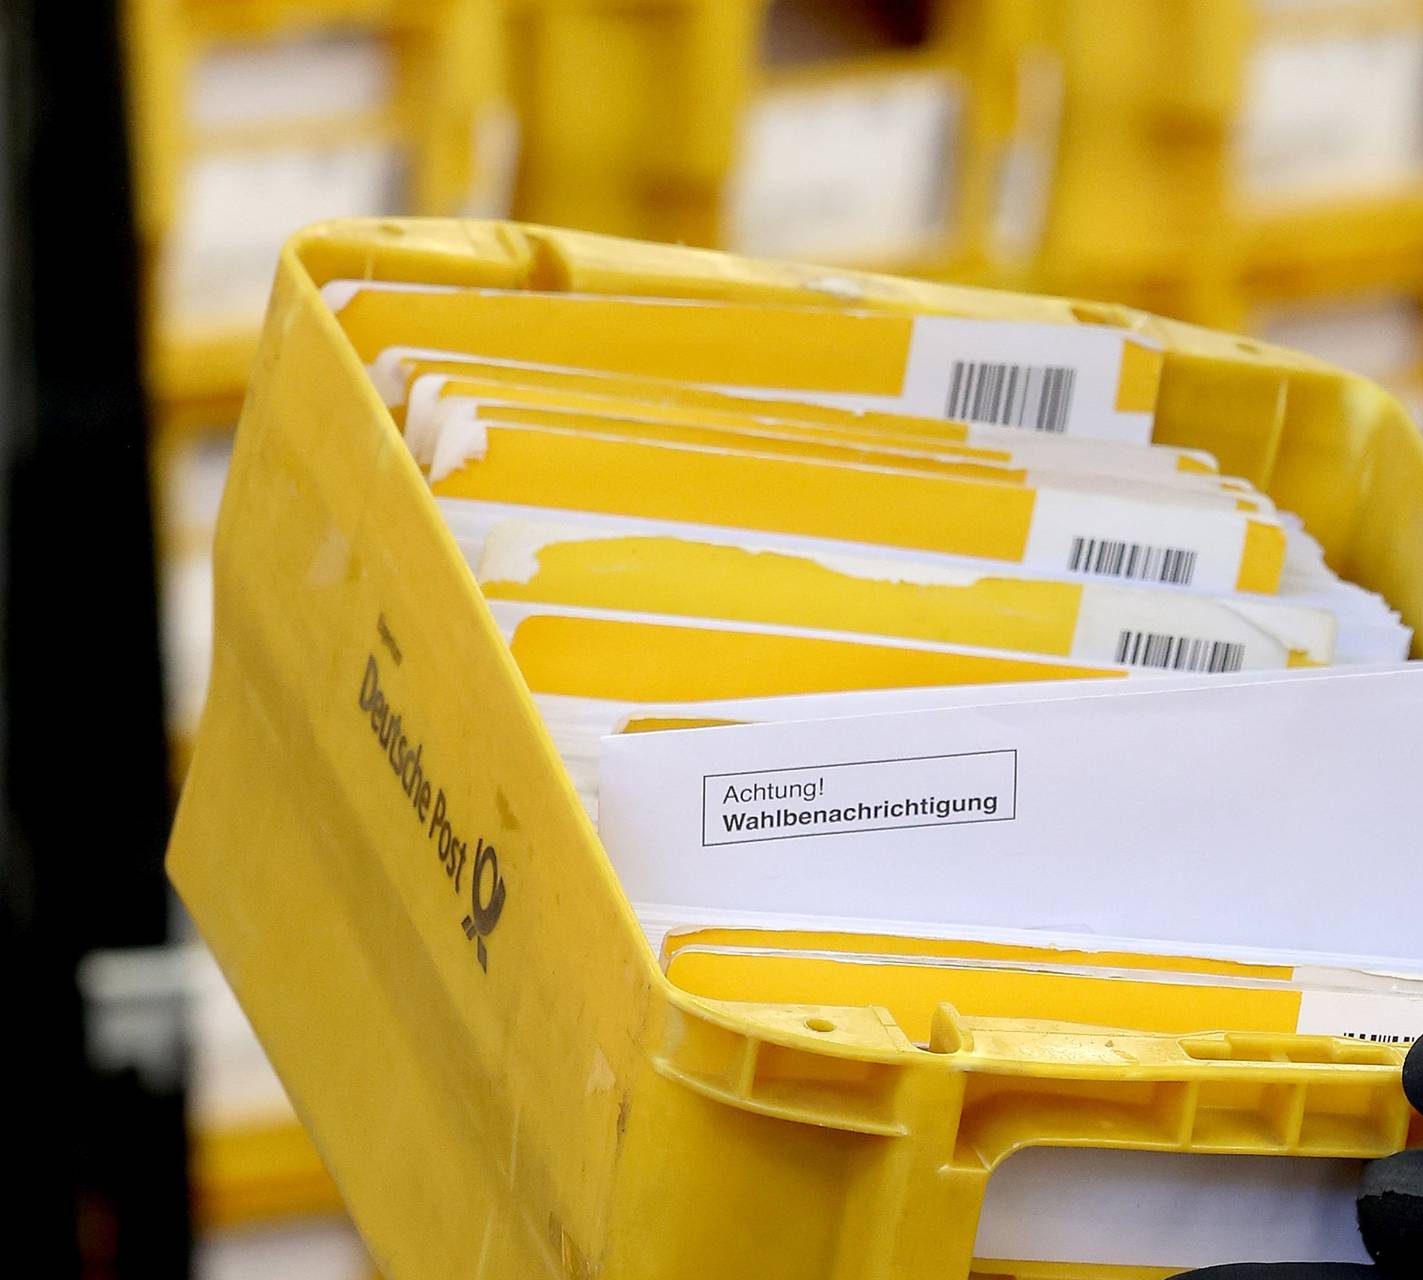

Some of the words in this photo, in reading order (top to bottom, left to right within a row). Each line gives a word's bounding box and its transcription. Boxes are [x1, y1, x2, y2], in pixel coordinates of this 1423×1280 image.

[359, 653, 431, 824] Deutsche
[428, 788, 467, 894] Post
[722, 777, 824, 805] Achtung!
[722, 795, 998, 833] Wahlbenachrichtigung
